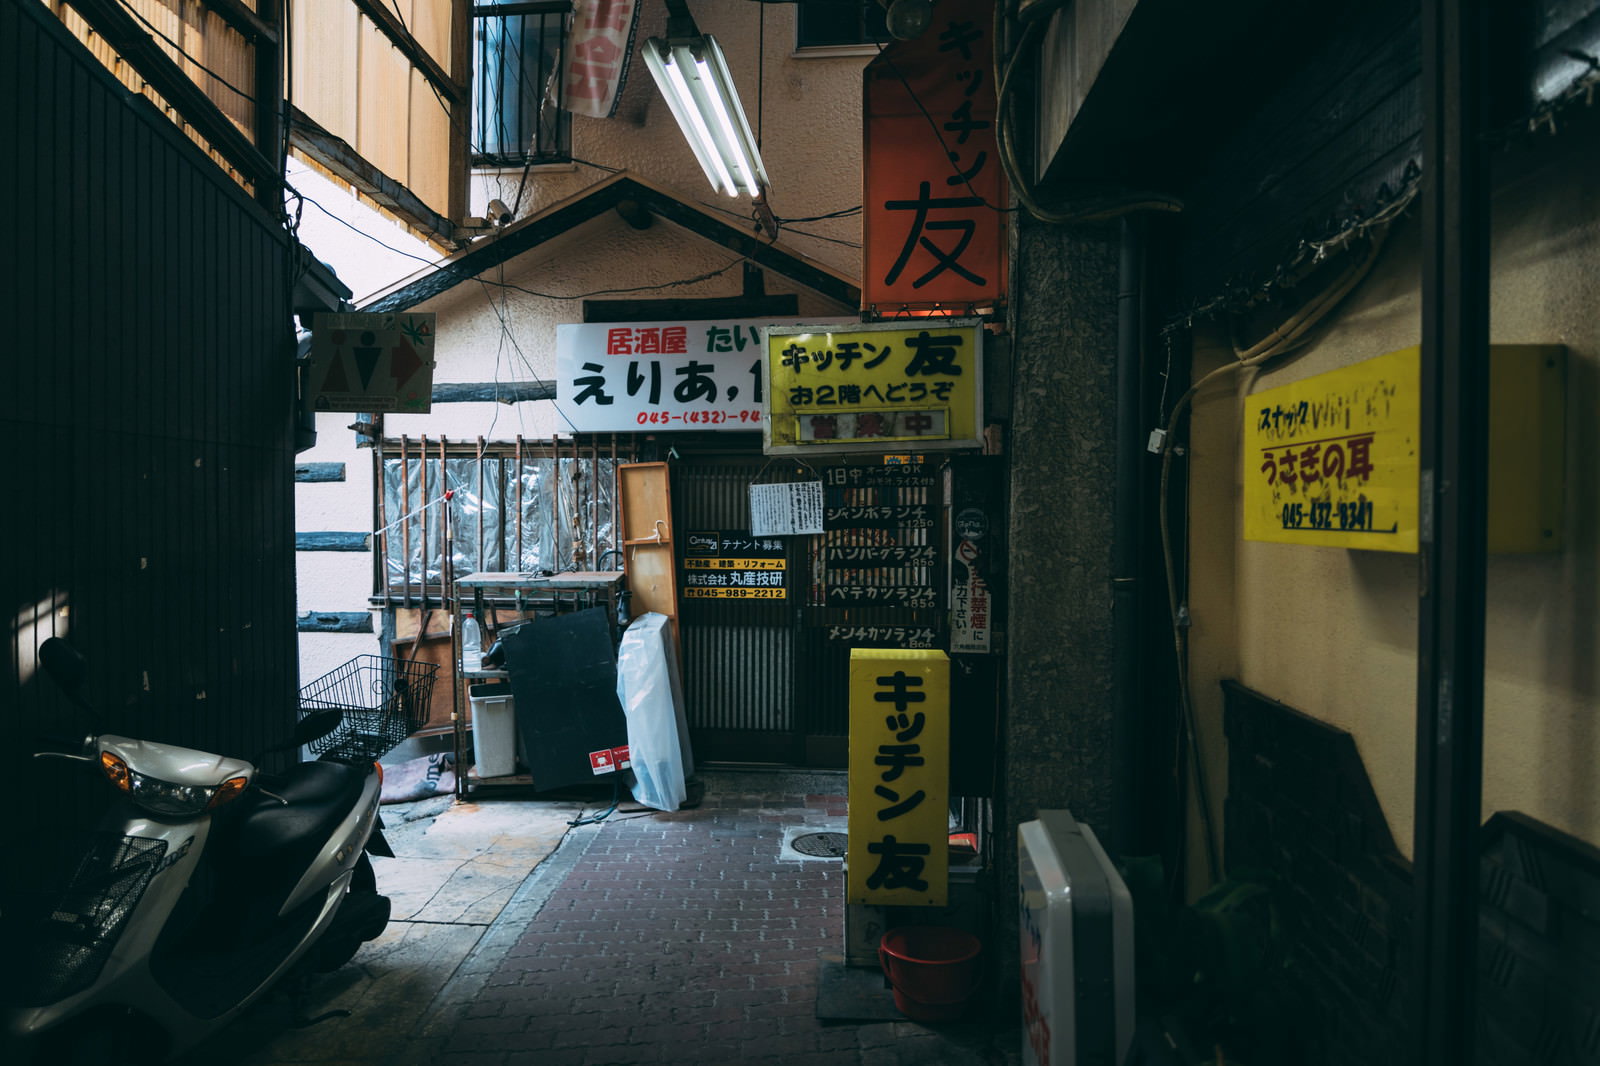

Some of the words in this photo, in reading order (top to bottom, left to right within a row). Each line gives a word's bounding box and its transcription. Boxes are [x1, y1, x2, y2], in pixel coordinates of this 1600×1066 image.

[938, 20, 990, 185] キッチン
[884, 181, 987, 290] 友
[607, 326, 688, 356] 居酒屋
[782, 342, 892, 374] キッチン
[904, 331, 963, 377] 友
[789, 382, 955, 406] お2階へどうぞ
[1261, 401, 1309, 431] スナック
[1261, 436, 1375, 486] うさぎの耳
[722, 539, 784, 551] テナント募集
[830, 546, 937, 560] ハンバーグランチ
[829, 626, 936, 642] メンチカツランチ
[874, 670, 926, 822] キッチン
[866, 834, 931, 892] 友
